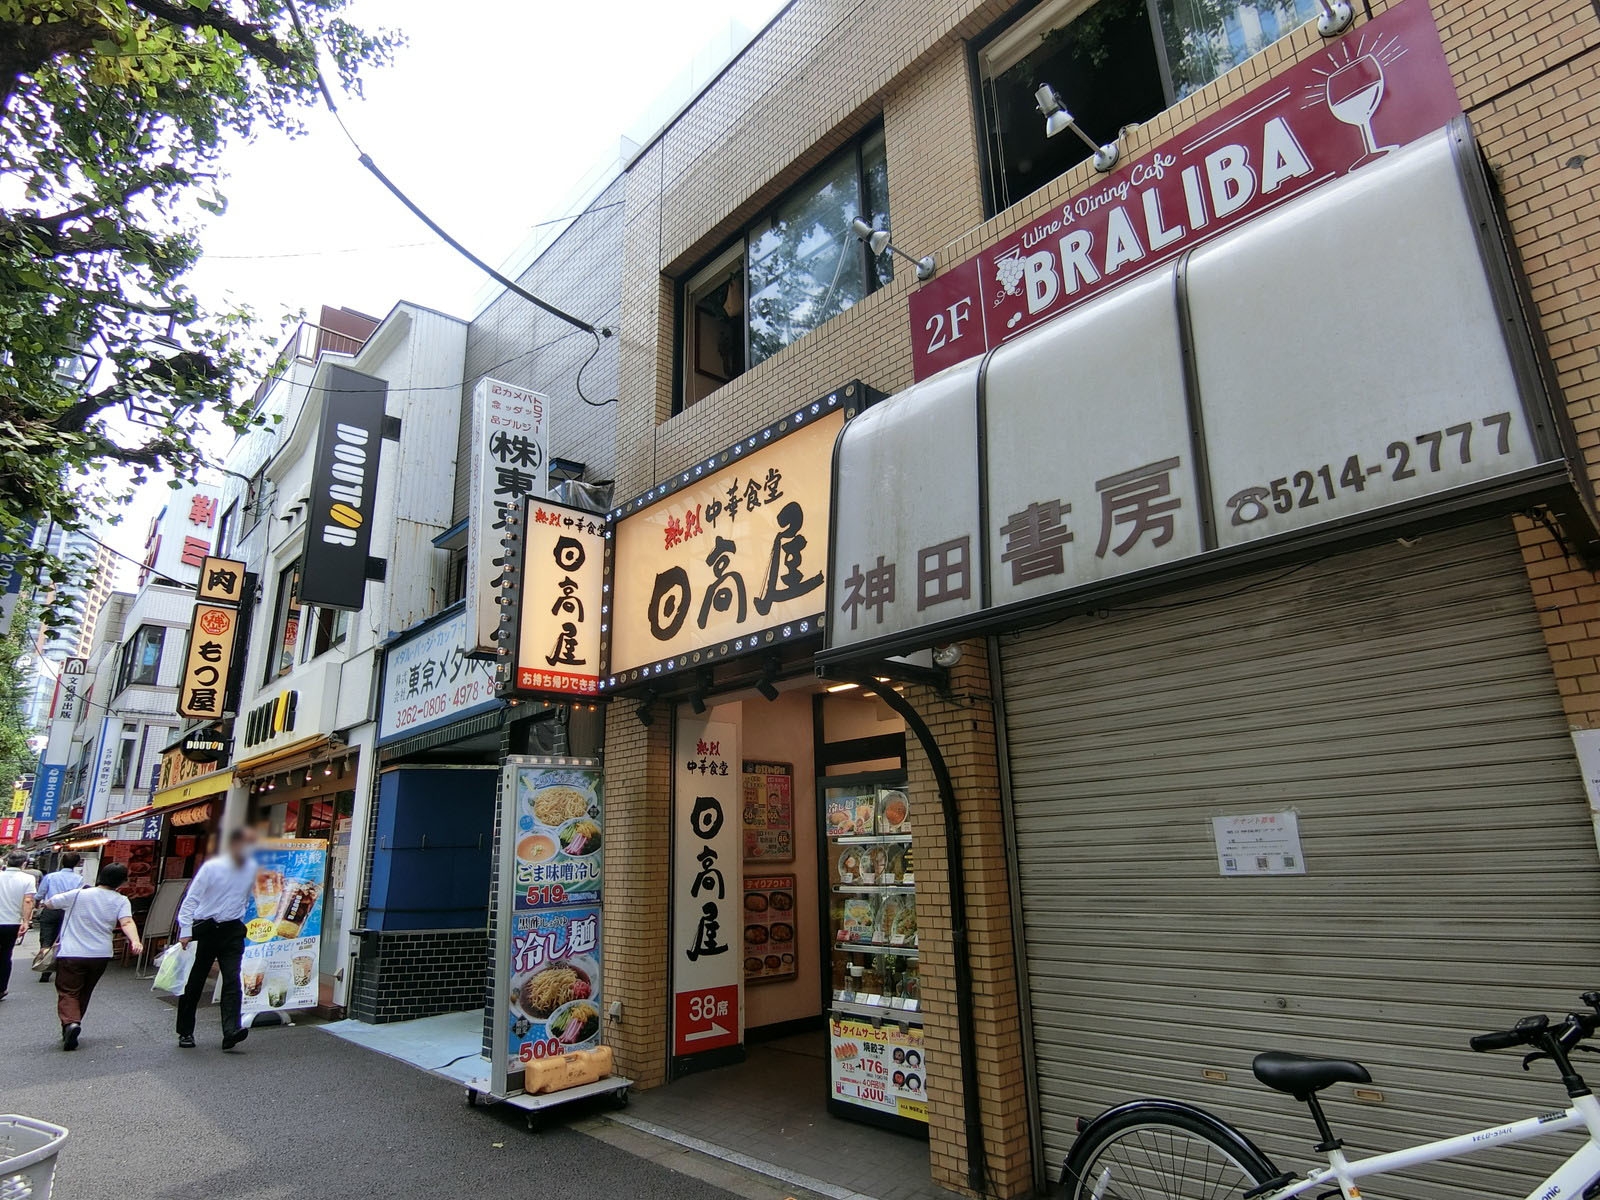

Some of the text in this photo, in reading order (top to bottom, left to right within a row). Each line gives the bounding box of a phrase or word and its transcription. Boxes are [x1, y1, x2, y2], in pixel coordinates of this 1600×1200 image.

[1021, 153, 1176, 249] Wine & Dining Cafe
[925, 116, 1314, 355] 2F BRALIBA
[323, 423, 369, 547] DOUTOR
[1269, 411, 1512, 515] 5214-2777
[664, 467, 784, 550] 熱烈 中華食堂
[647, 501, 825, 642] 日高屋
[840, 456, 1182, 631] 神田書房
[207, 568, 238, 594] 肉
[545, 535, 587, 667] 日高屋
[187, 641, 223, 712] もつ屋
[522, 671, 599, 693] お持ち帰りできま
[186, 740, 224, 751] DOUTOR
[686, 757, 729, 777] 中華食堂
[696, 738, 721, 756] 熱烈
[518, 862, 600, 882] ごま味噌冷し
[526, 884, 569, 905] 519円
[686, 796, 729, 962] 日高屋
[514, 914, 598, 973] 冷し麺
[688, 994, 729, 1022] 38席
[842, 1027, 889, 1041] タイムサービス
[863, 1042, 886, 1055] 焼餃子
